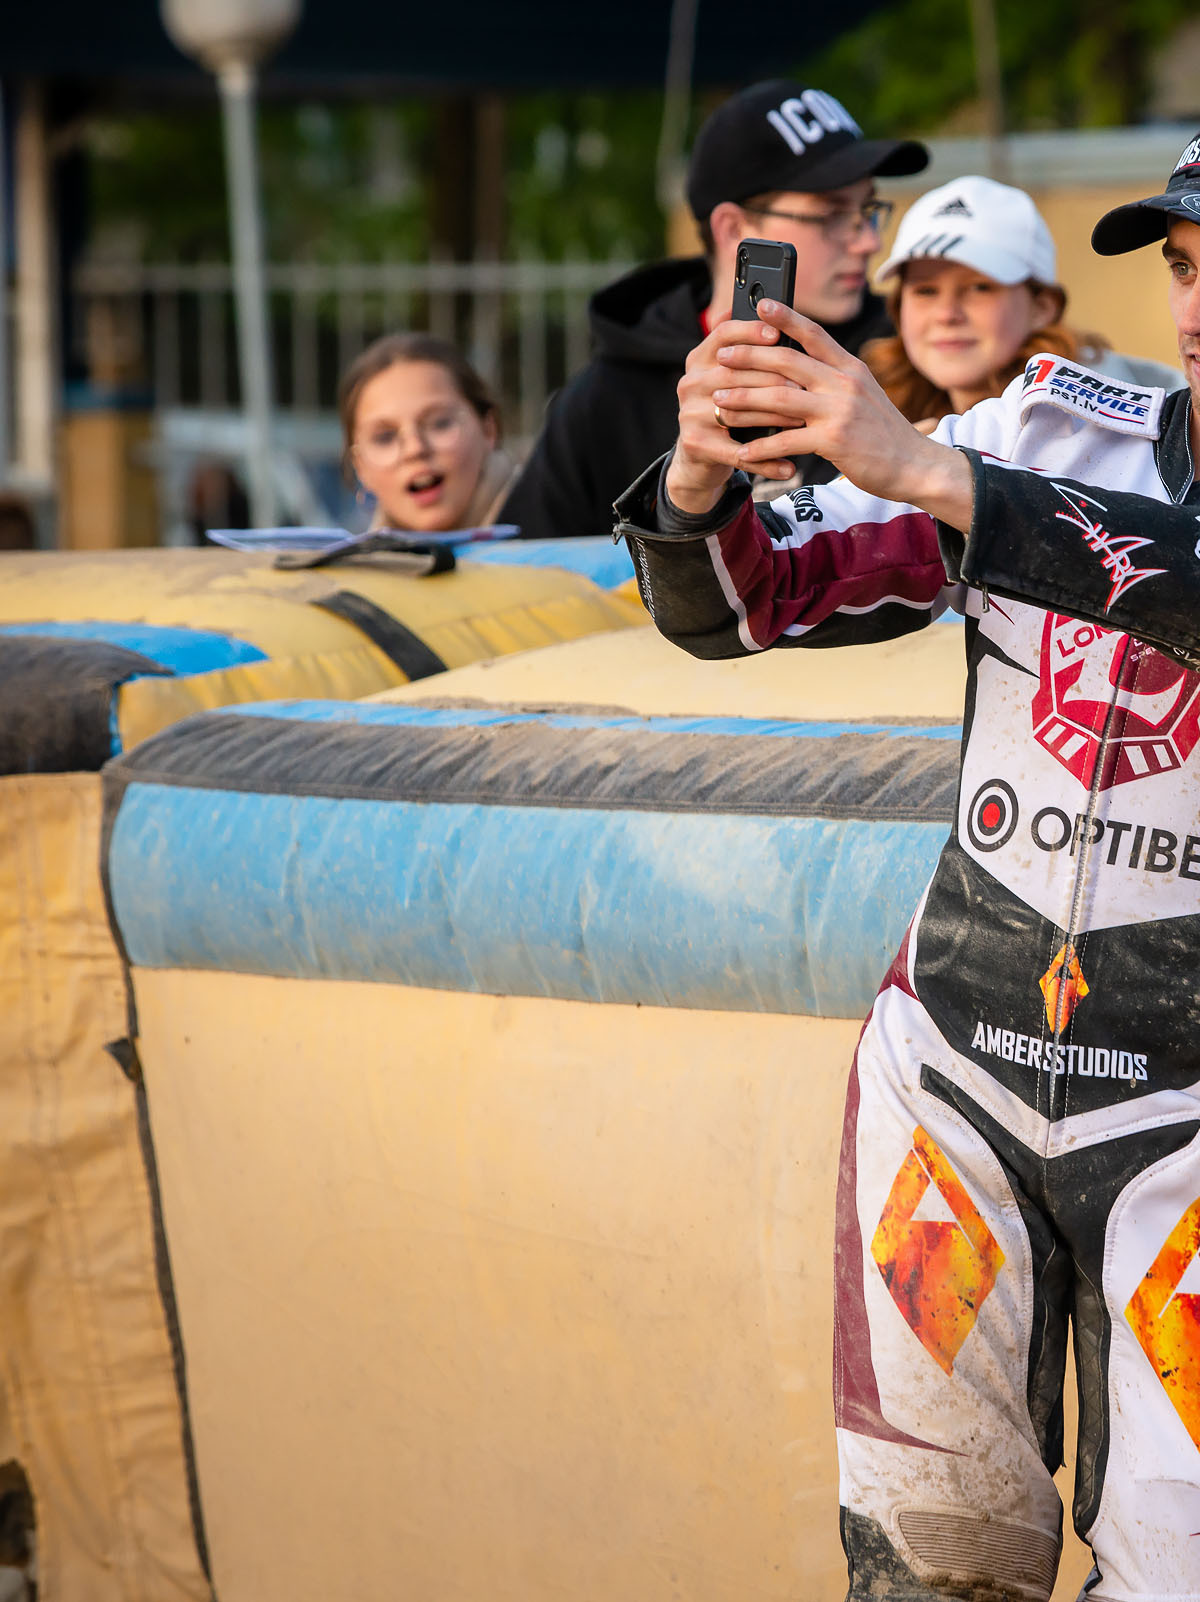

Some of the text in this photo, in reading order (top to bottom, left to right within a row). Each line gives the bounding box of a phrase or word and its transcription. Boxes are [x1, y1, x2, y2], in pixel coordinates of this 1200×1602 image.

[1049, 377, 1150, 417] SERVICE
[1050, 387, 1098, 413] ps1.lv
[1055, 366, 1153, 402] PART
